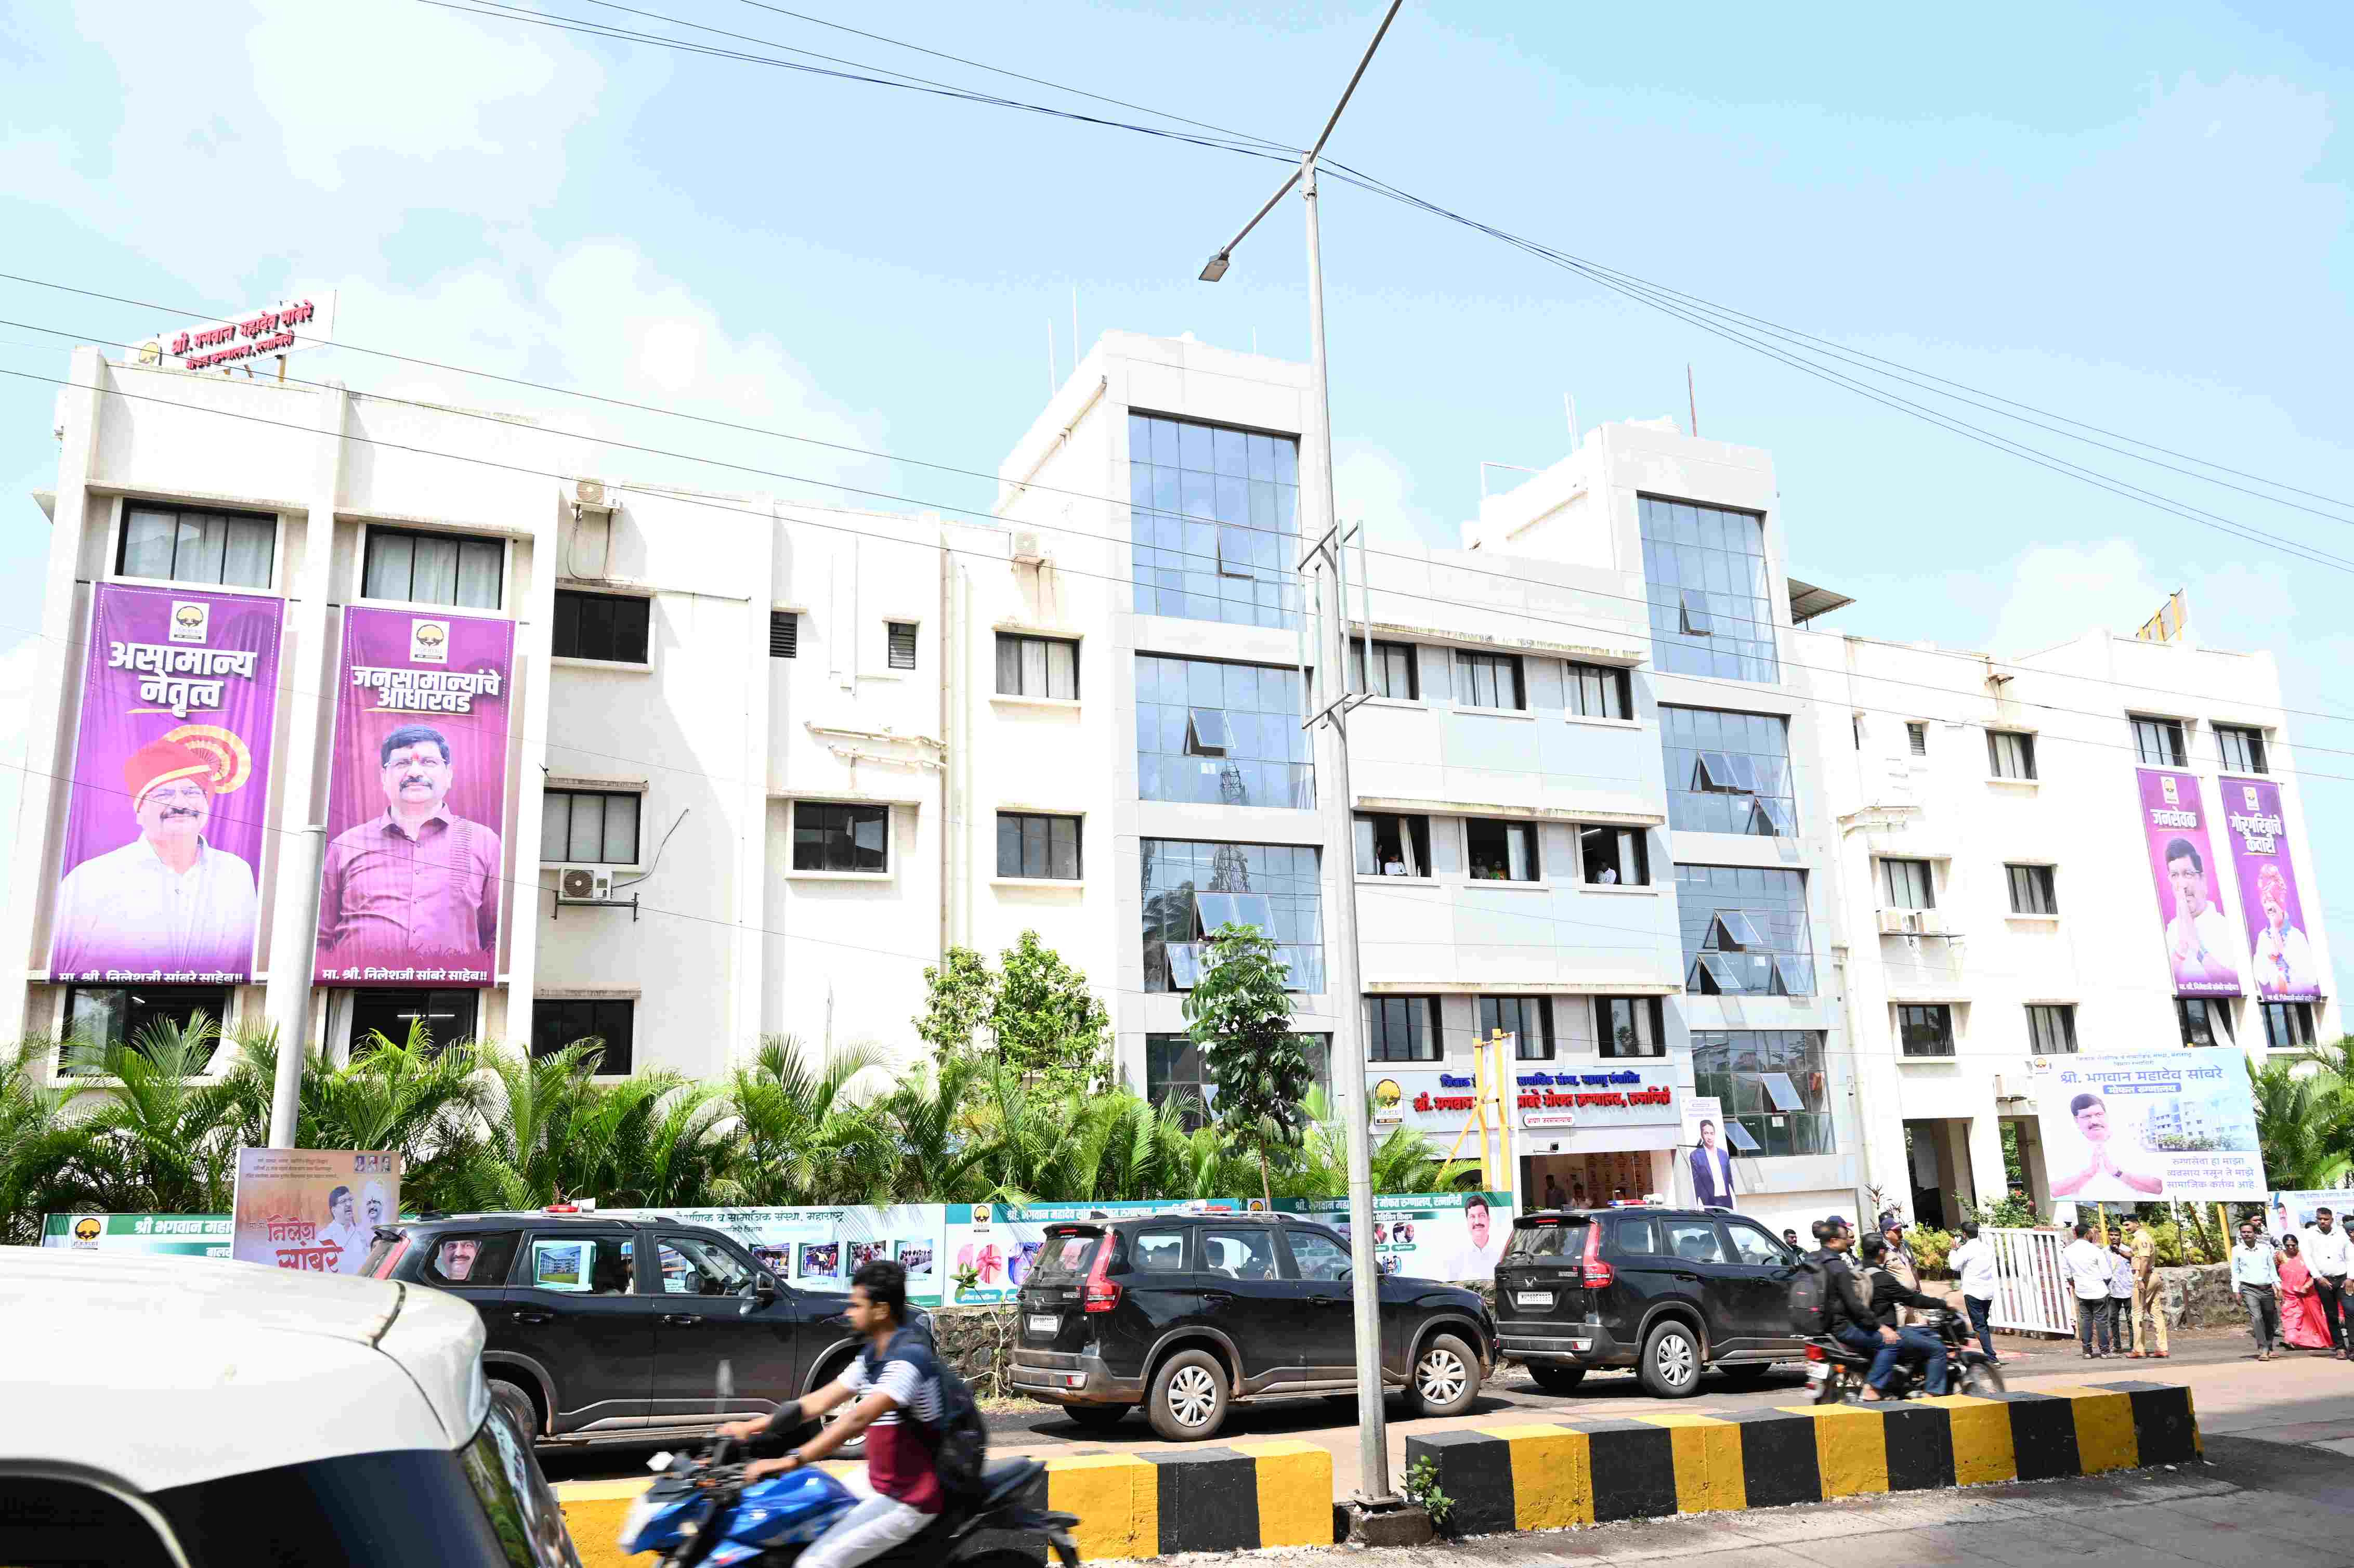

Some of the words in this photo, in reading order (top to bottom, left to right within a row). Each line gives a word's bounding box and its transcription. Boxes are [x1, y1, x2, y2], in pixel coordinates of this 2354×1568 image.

[108, 641, 258, 677] असामान्य
[350, 665, 502, 696] जनसामान्यांचे
[138, 667, 225, 718] नेतृत्व
[377, 686, 473, 712] आधारवड
[2150, 806, 2196, 828] जनसेवक
[106, 970, 162, 982] निलेशजी
[163, 971, 198, 982] सांबरे
[364, 967, 415, 981] निलेशजी
[416, 968, 447, 981] सांबरे
[2061, 1071, 2082, 1083] श्री.
[2085, 1072, 2131, 1082] भगवान
[2135, 1066, 2181, 1081] महादेव
[2187, 1065, 2224, 1079] सांबरे
[134, 1217, 154, 1234] श्री
[155, 1220, 204, 1234] भगवान
[205, 1220, 233, 1234] महा
